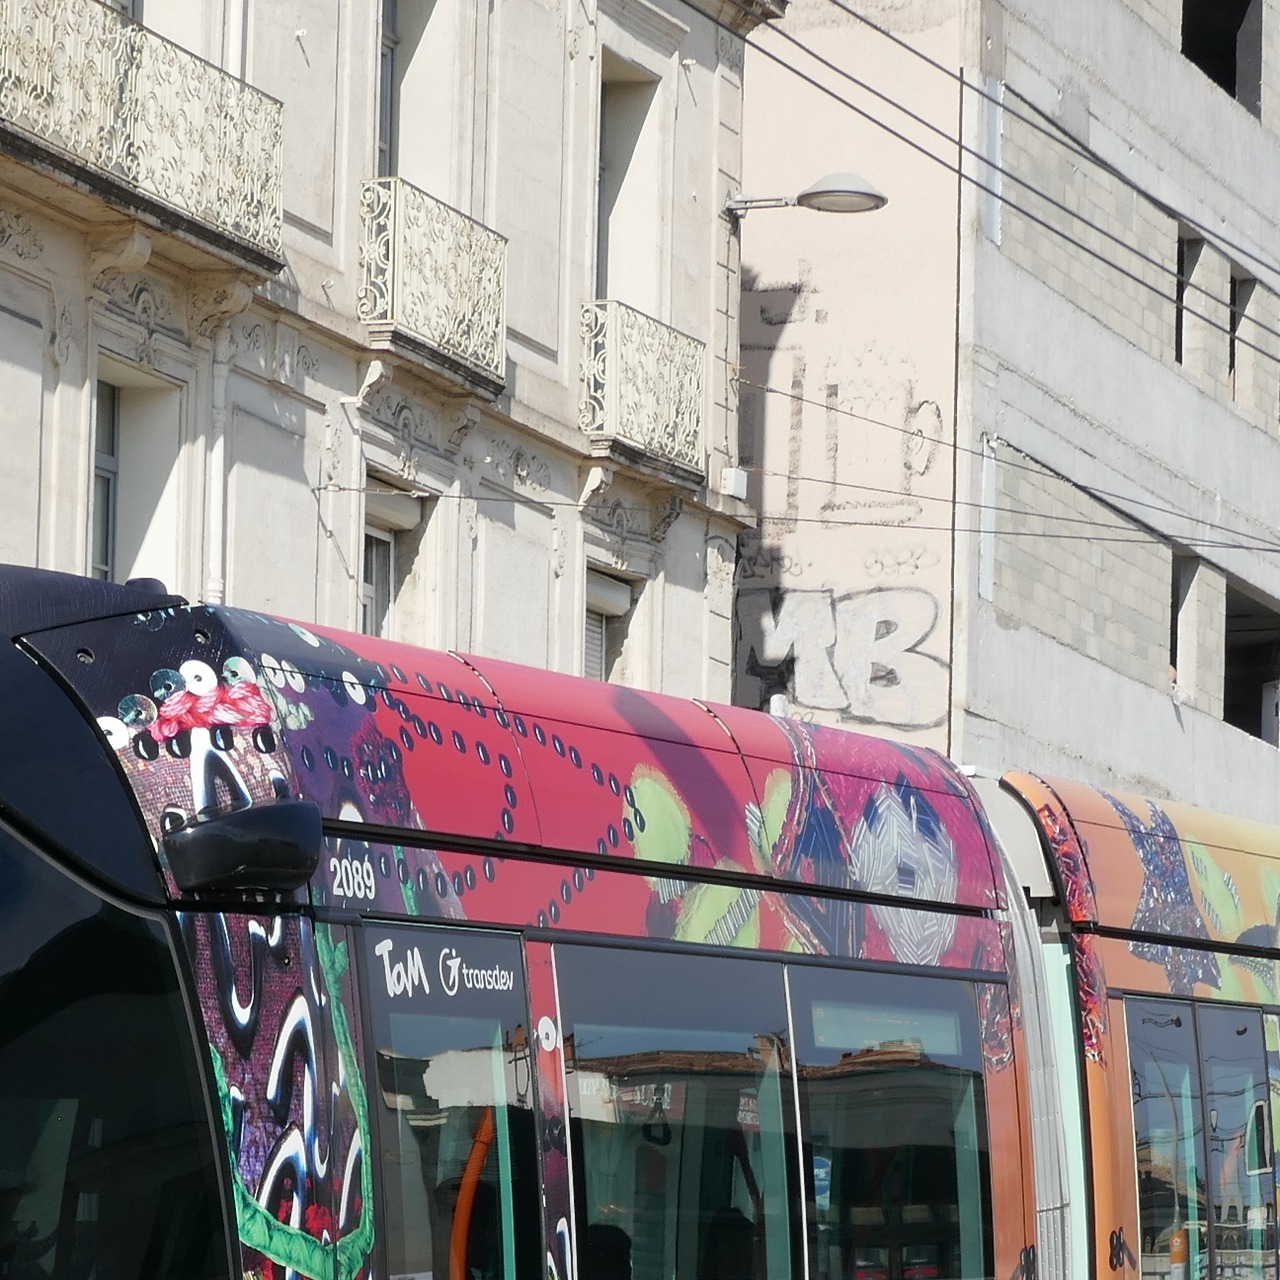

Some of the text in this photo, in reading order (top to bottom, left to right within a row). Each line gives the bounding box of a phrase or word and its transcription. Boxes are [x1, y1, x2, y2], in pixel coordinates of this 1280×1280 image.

[330, 857, 376, 900] 2089
[375, 938, 430, 998] TaM
[462, 963, 514, 991] transdev
